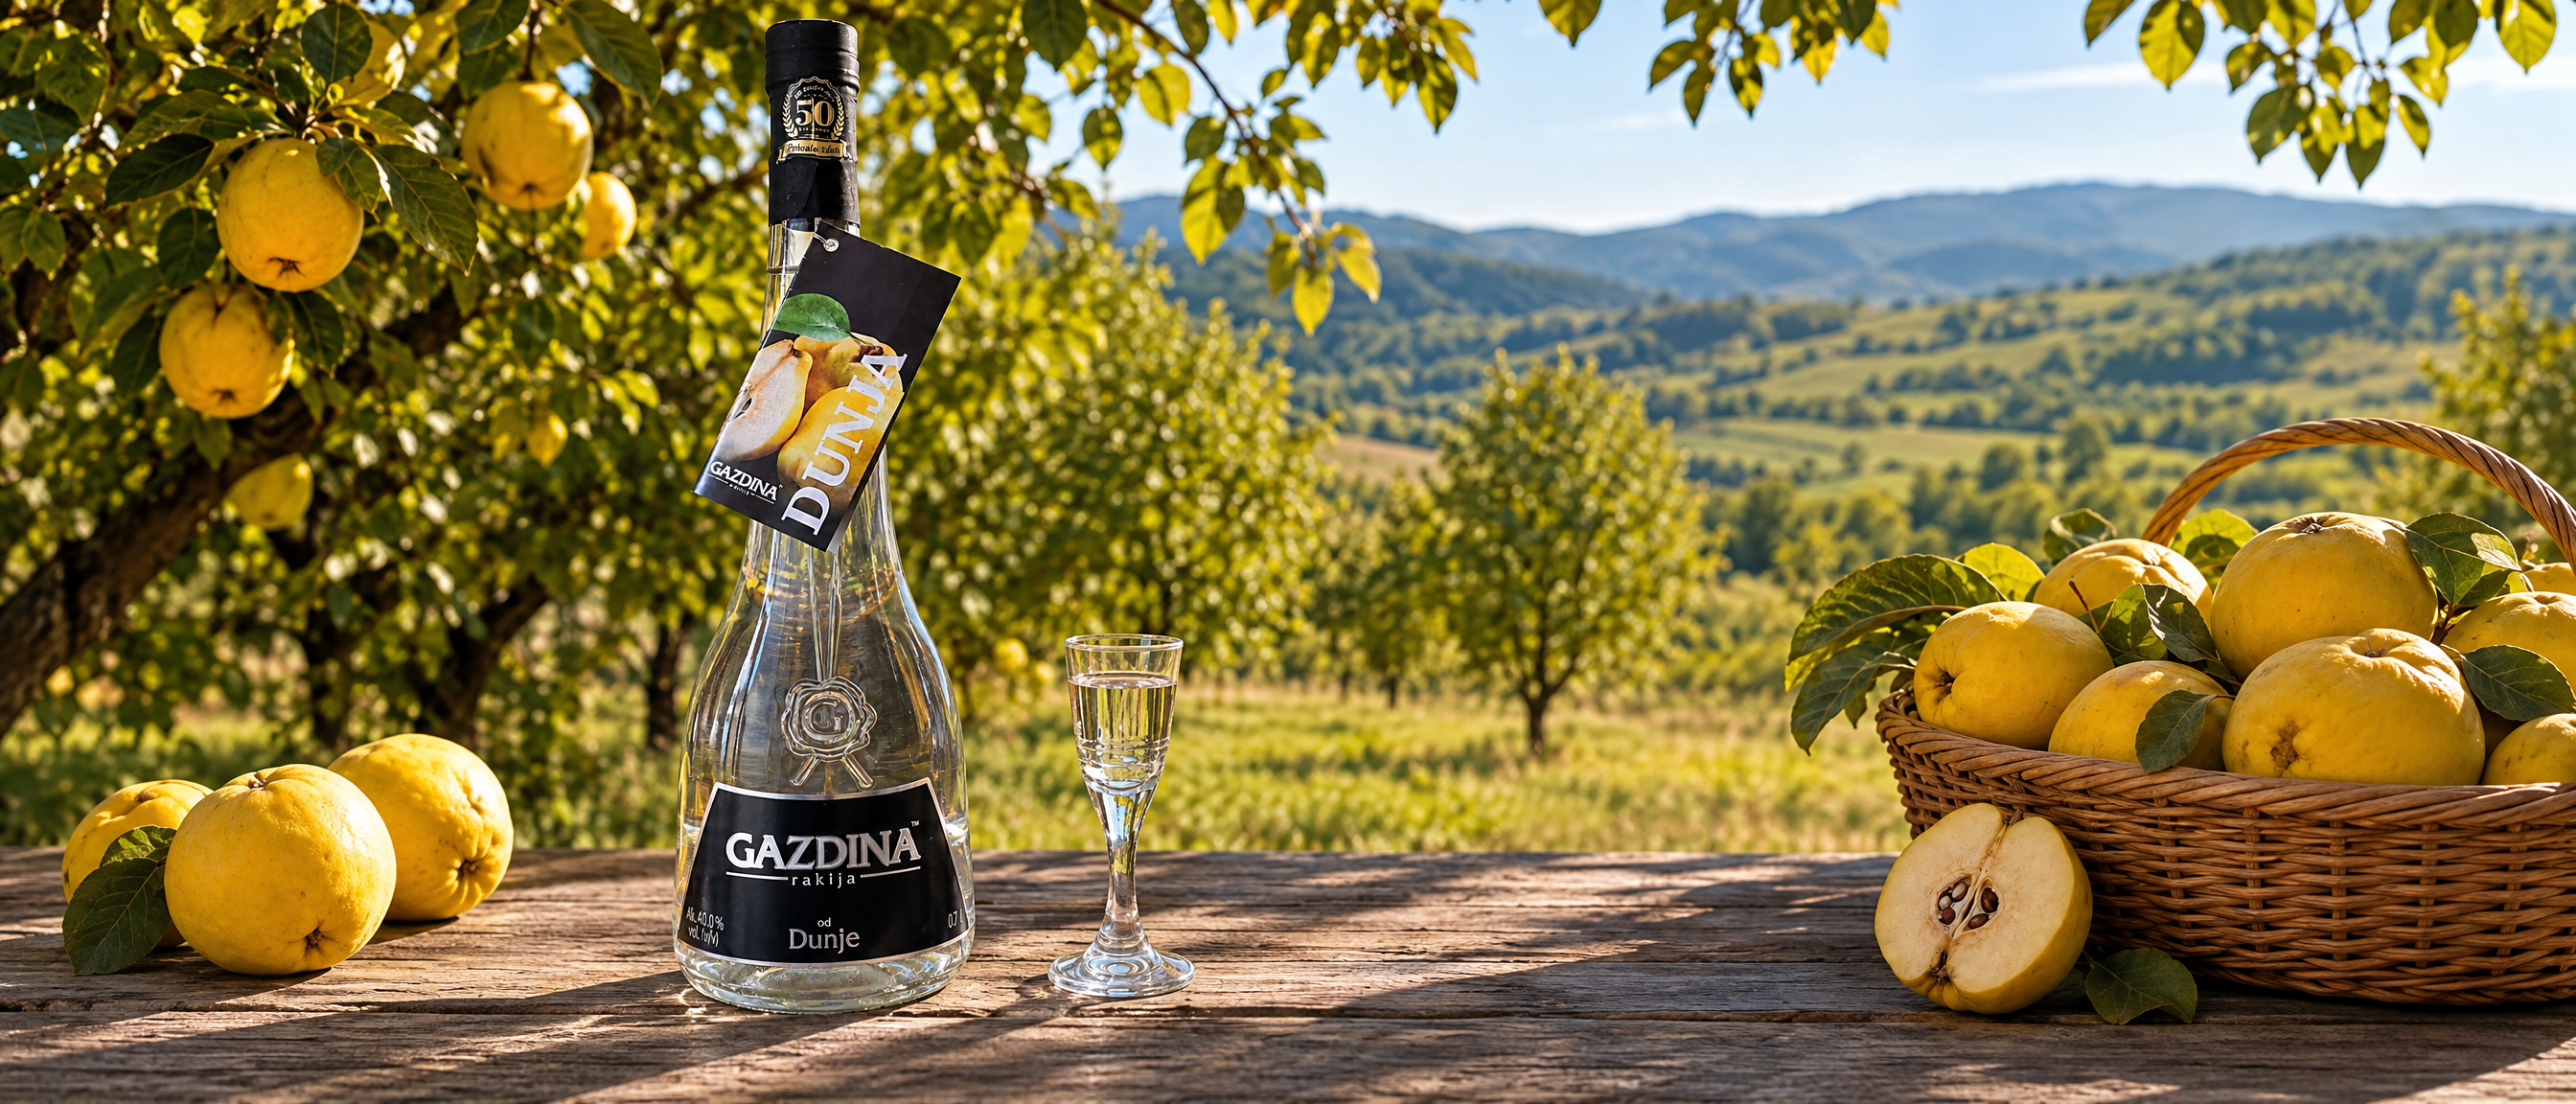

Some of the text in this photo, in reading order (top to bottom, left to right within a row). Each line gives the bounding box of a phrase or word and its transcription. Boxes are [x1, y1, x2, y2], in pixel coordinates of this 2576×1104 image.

[794, 100, 835, 126] 50
[781, 354, 908, 536] DUNJA
[710, 461, 777, 501] GAZDINA
[725, 827, 921, 870] GAZDINA
[792, 873, 856, 888] rakija
[816, 917, 832, 928] od
[789, 928, 861, 954] Dunje
